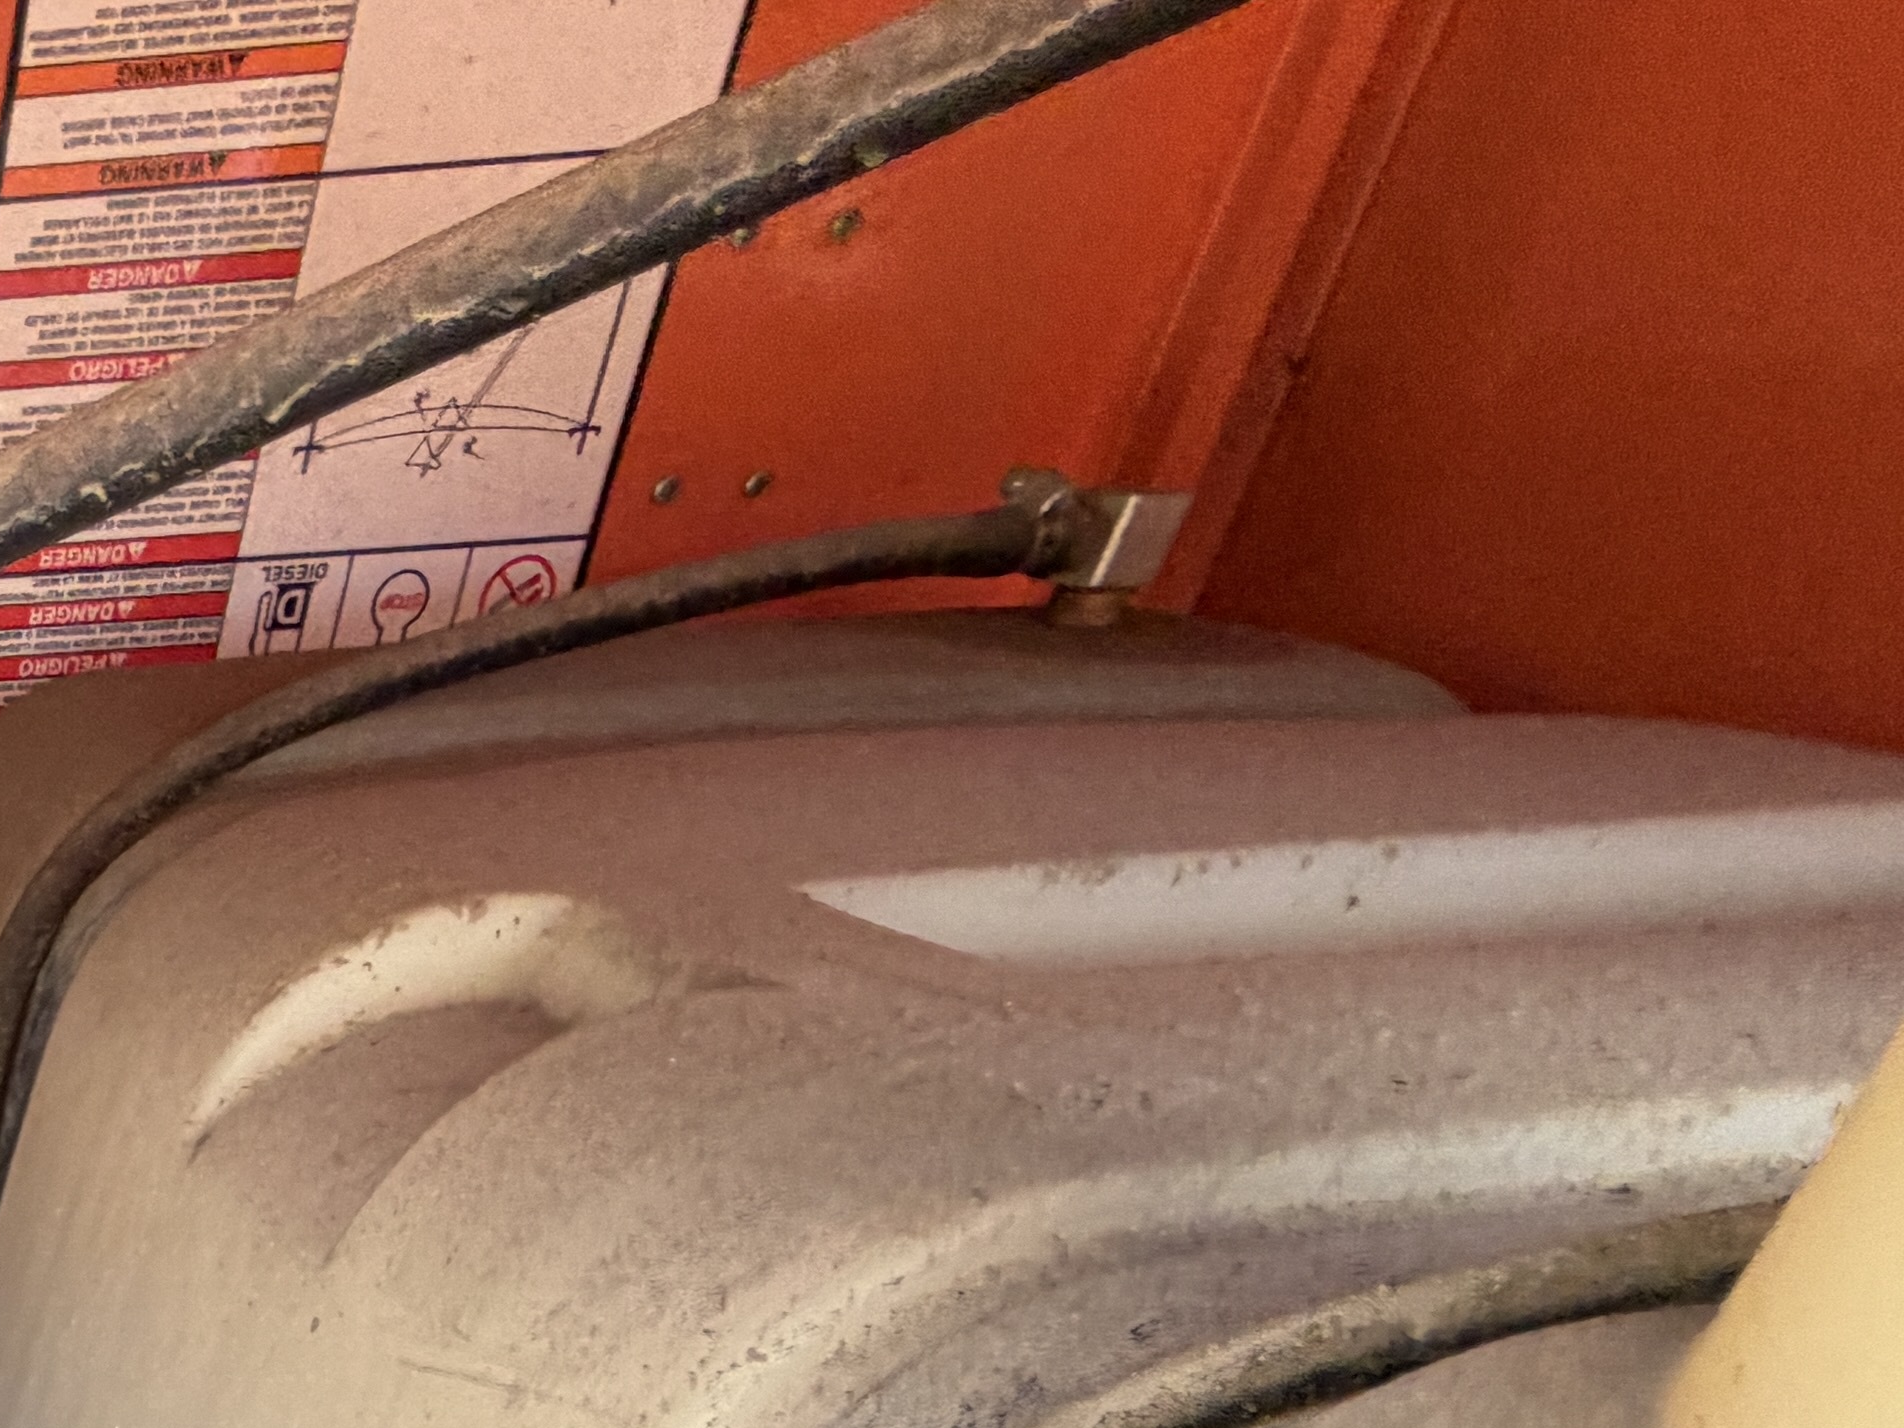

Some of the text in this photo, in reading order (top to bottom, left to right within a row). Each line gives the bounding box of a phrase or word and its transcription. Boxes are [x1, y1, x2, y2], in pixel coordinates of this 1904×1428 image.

[114, 59, 224, 87] WARNING
[99, 161, 204, 186] WARNING
[87, 262, 180, 289] DANGER
[68, 356, 165, 381] PELIGRO
[39, 545, 126, 567] DANGER
[262, 562, 328, 583] DIESEL
[380, 592, 424, 611] STOP
[29, 603, 114, 625] DANGER
[19, 653, 107, 677] PELIGRO
